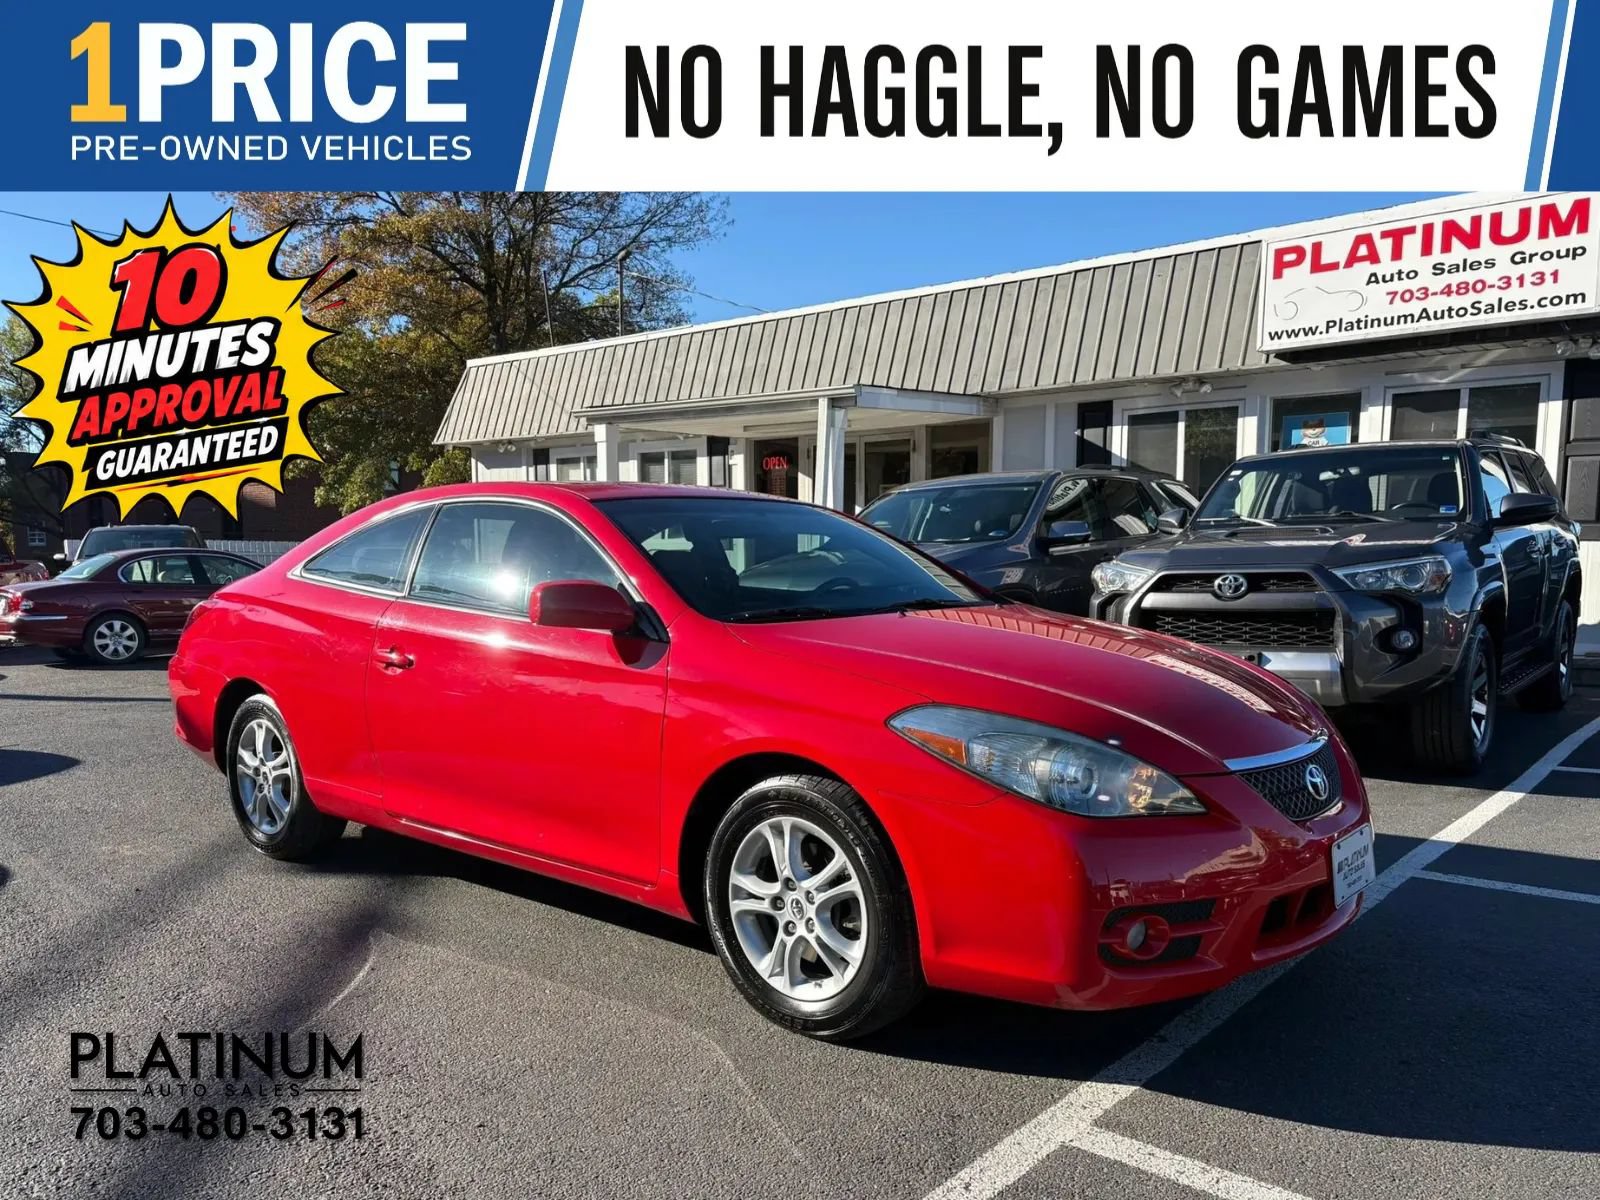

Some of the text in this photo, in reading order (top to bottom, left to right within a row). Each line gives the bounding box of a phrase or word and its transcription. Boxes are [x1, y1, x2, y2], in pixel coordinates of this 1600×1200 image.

[1272, 197, 1591, 280] PLATINUM
[1365, 245, 1587, 286] Auto Sales Group
[1385, 269, 1560, 305] 703-480-3131
[1268, 291, 1587, 341] www.PlatinumAutoSales.com
[762, 455, 788, 470] OPEN
